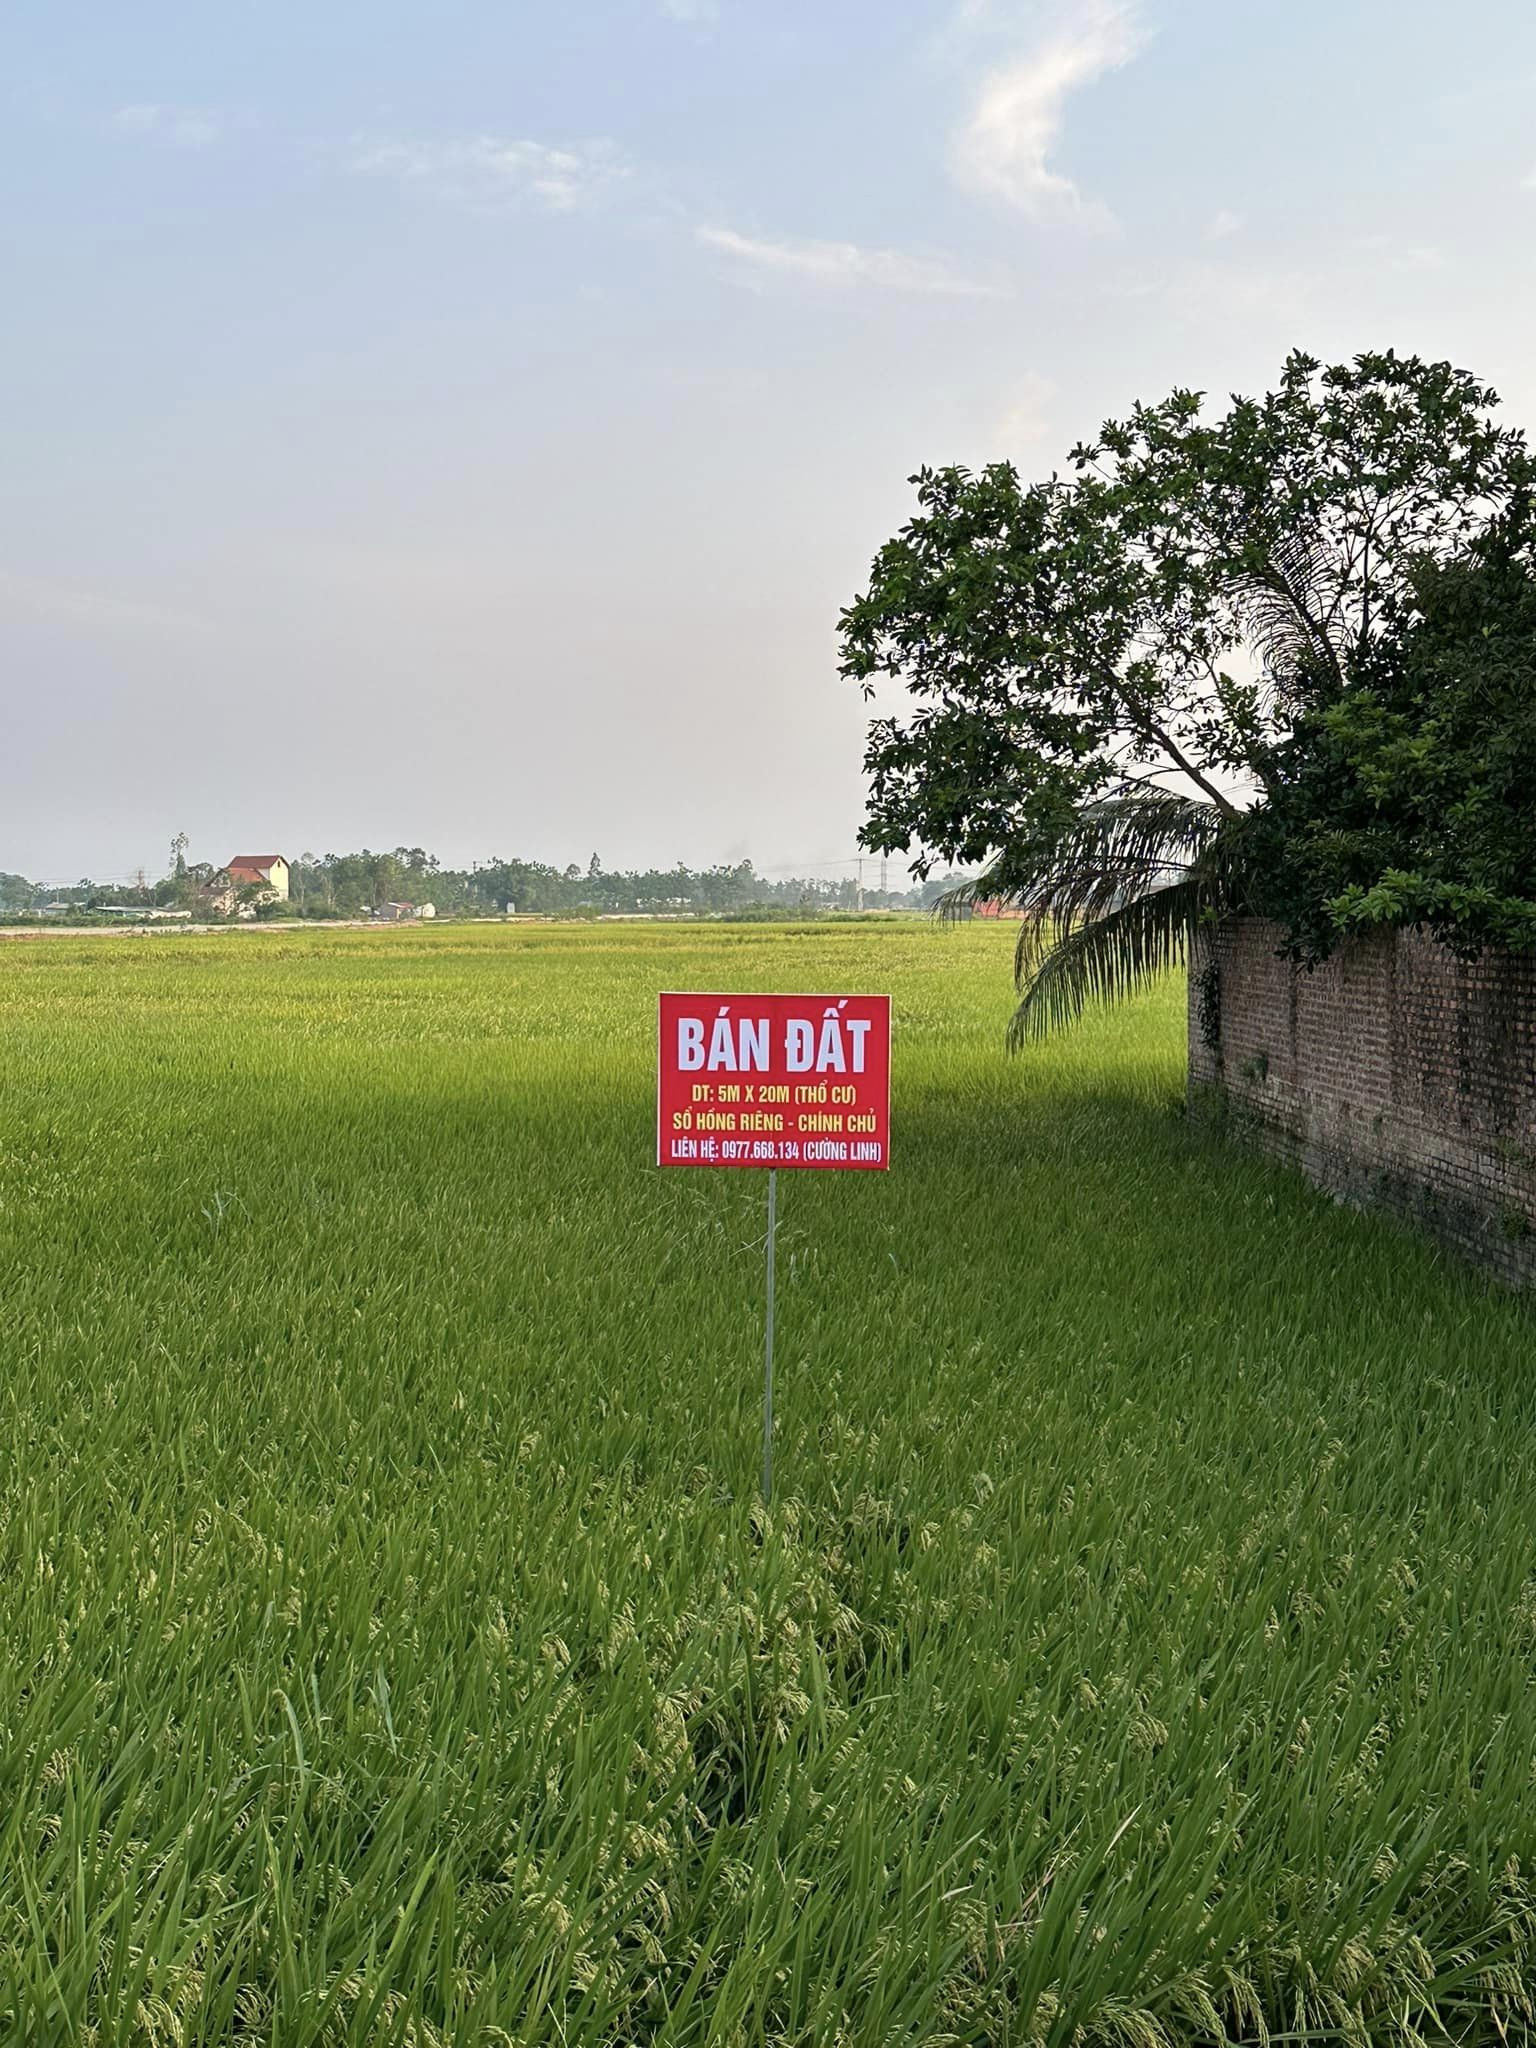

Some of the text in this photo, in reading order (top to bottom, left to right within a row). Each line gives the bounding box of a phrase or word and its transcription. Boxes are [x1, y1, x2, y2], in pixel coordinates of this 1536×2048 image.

[678, 1000, 872, 1073] BÁN ĐẤT
[692, 1079, 857, 1106] DT: 5M X 20M (THỔ CƯ)
[673, 1106, 693, 1131] SỔ
[696, 1107, 736, 1131] HỒNG
[740, 1110, 784, 1132] RIÊNG
[798, 1110, 843, 1132] CHÍNH
[847, 1107, 877, 1133] CHỦ
[671, 1136, 882, 1163] LIÊN HỆ: 0977.668.134 (CƯỜNG LINH)
